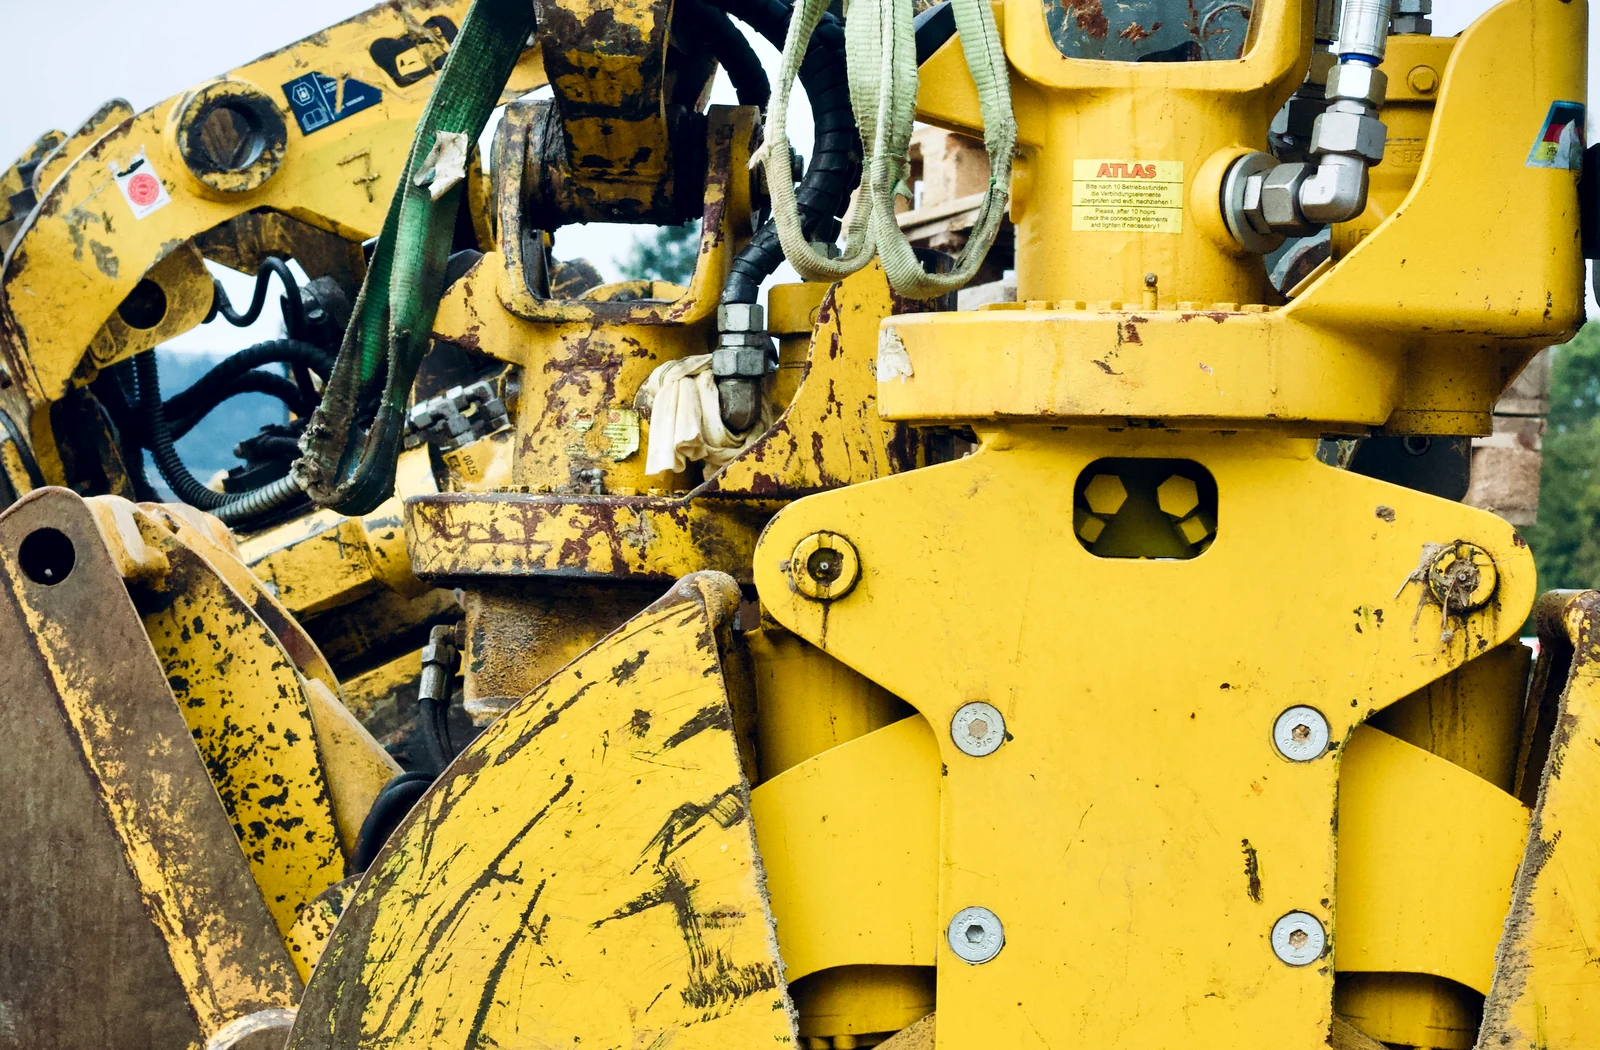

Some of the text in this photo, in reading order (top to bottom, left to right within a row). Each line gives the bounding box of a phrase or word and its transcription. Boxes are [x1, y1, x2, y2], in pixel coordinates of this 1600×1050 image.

[1096, 163, 1157, 179] ATLAS
[1100, 191, 1161, 199] Verbindungselemente
[1110, 215, 1141, 223] connecting
